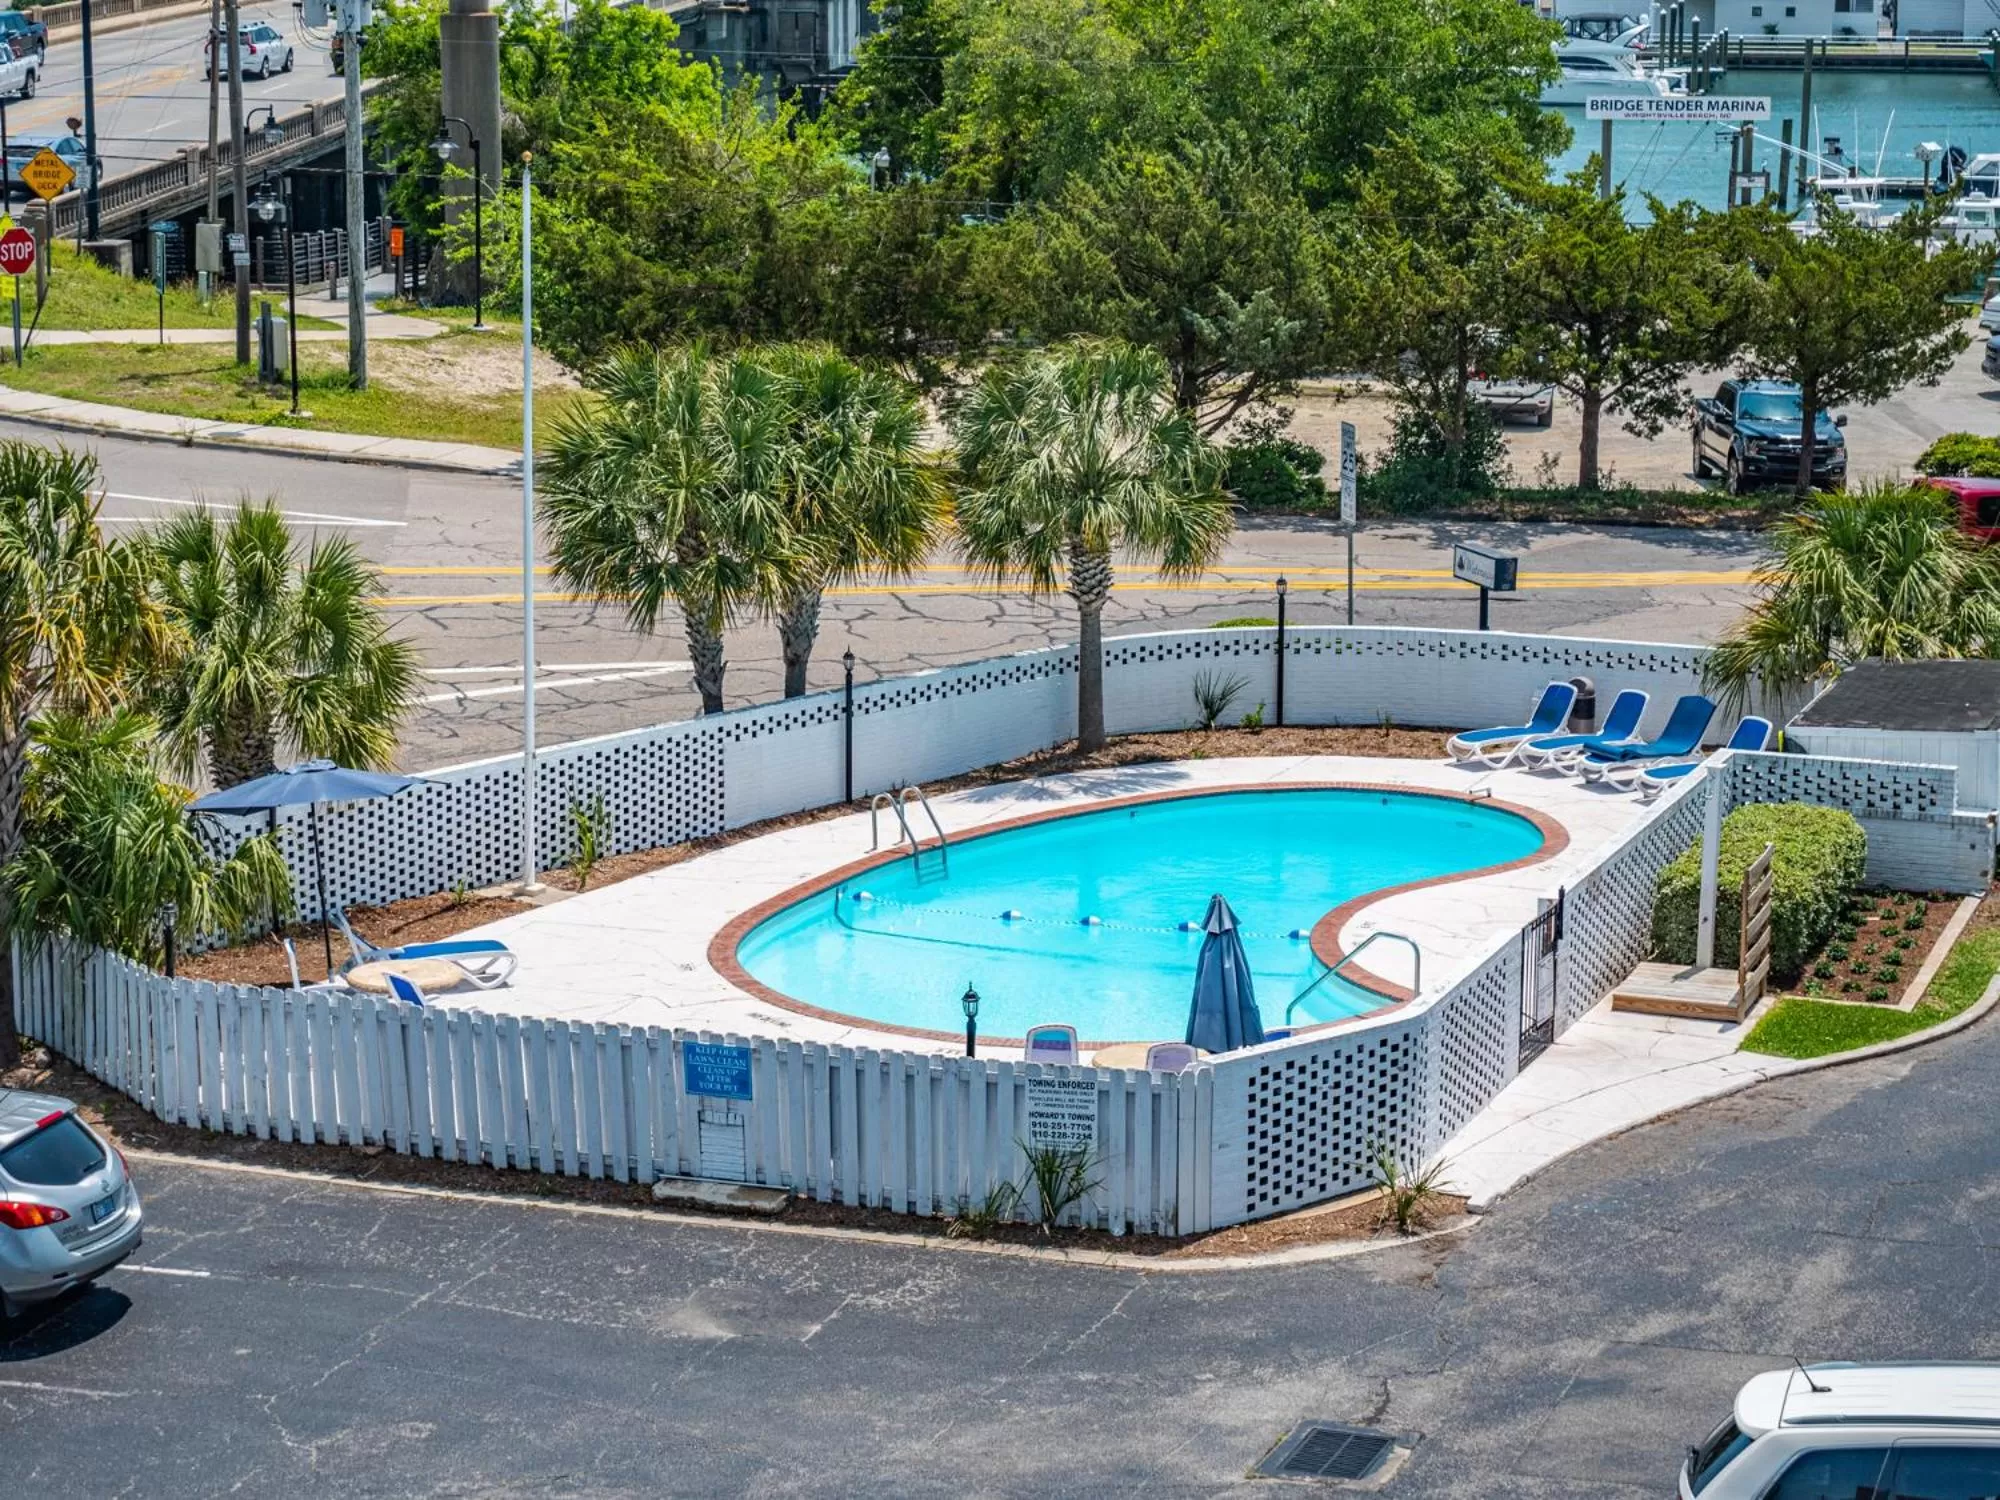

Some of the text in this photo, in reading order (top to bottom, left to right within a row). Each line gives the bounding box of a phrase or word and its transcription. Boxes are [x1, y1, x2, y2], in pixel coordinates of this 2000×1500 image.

[1590, 99, 1766, 112] BRIDGE TENDER MARINA
[34, 159, 58, 168] METAL
[33, 170, 61, 179] BRIDGE
[0, 243, 33, 262] STOP
[1342, 450, 1354, 473] 25
[695, 1046, 717, 1055] KEEP
[688, 1053, 746, 1067] LAWN CLEAN
[698, 1066, 725, 1075] CLEAN
[1028, 1079, 1096, 1090] TOWING ENFORCED
[1028, 1111, 1096, 1122] HOWARD'S TOWING
